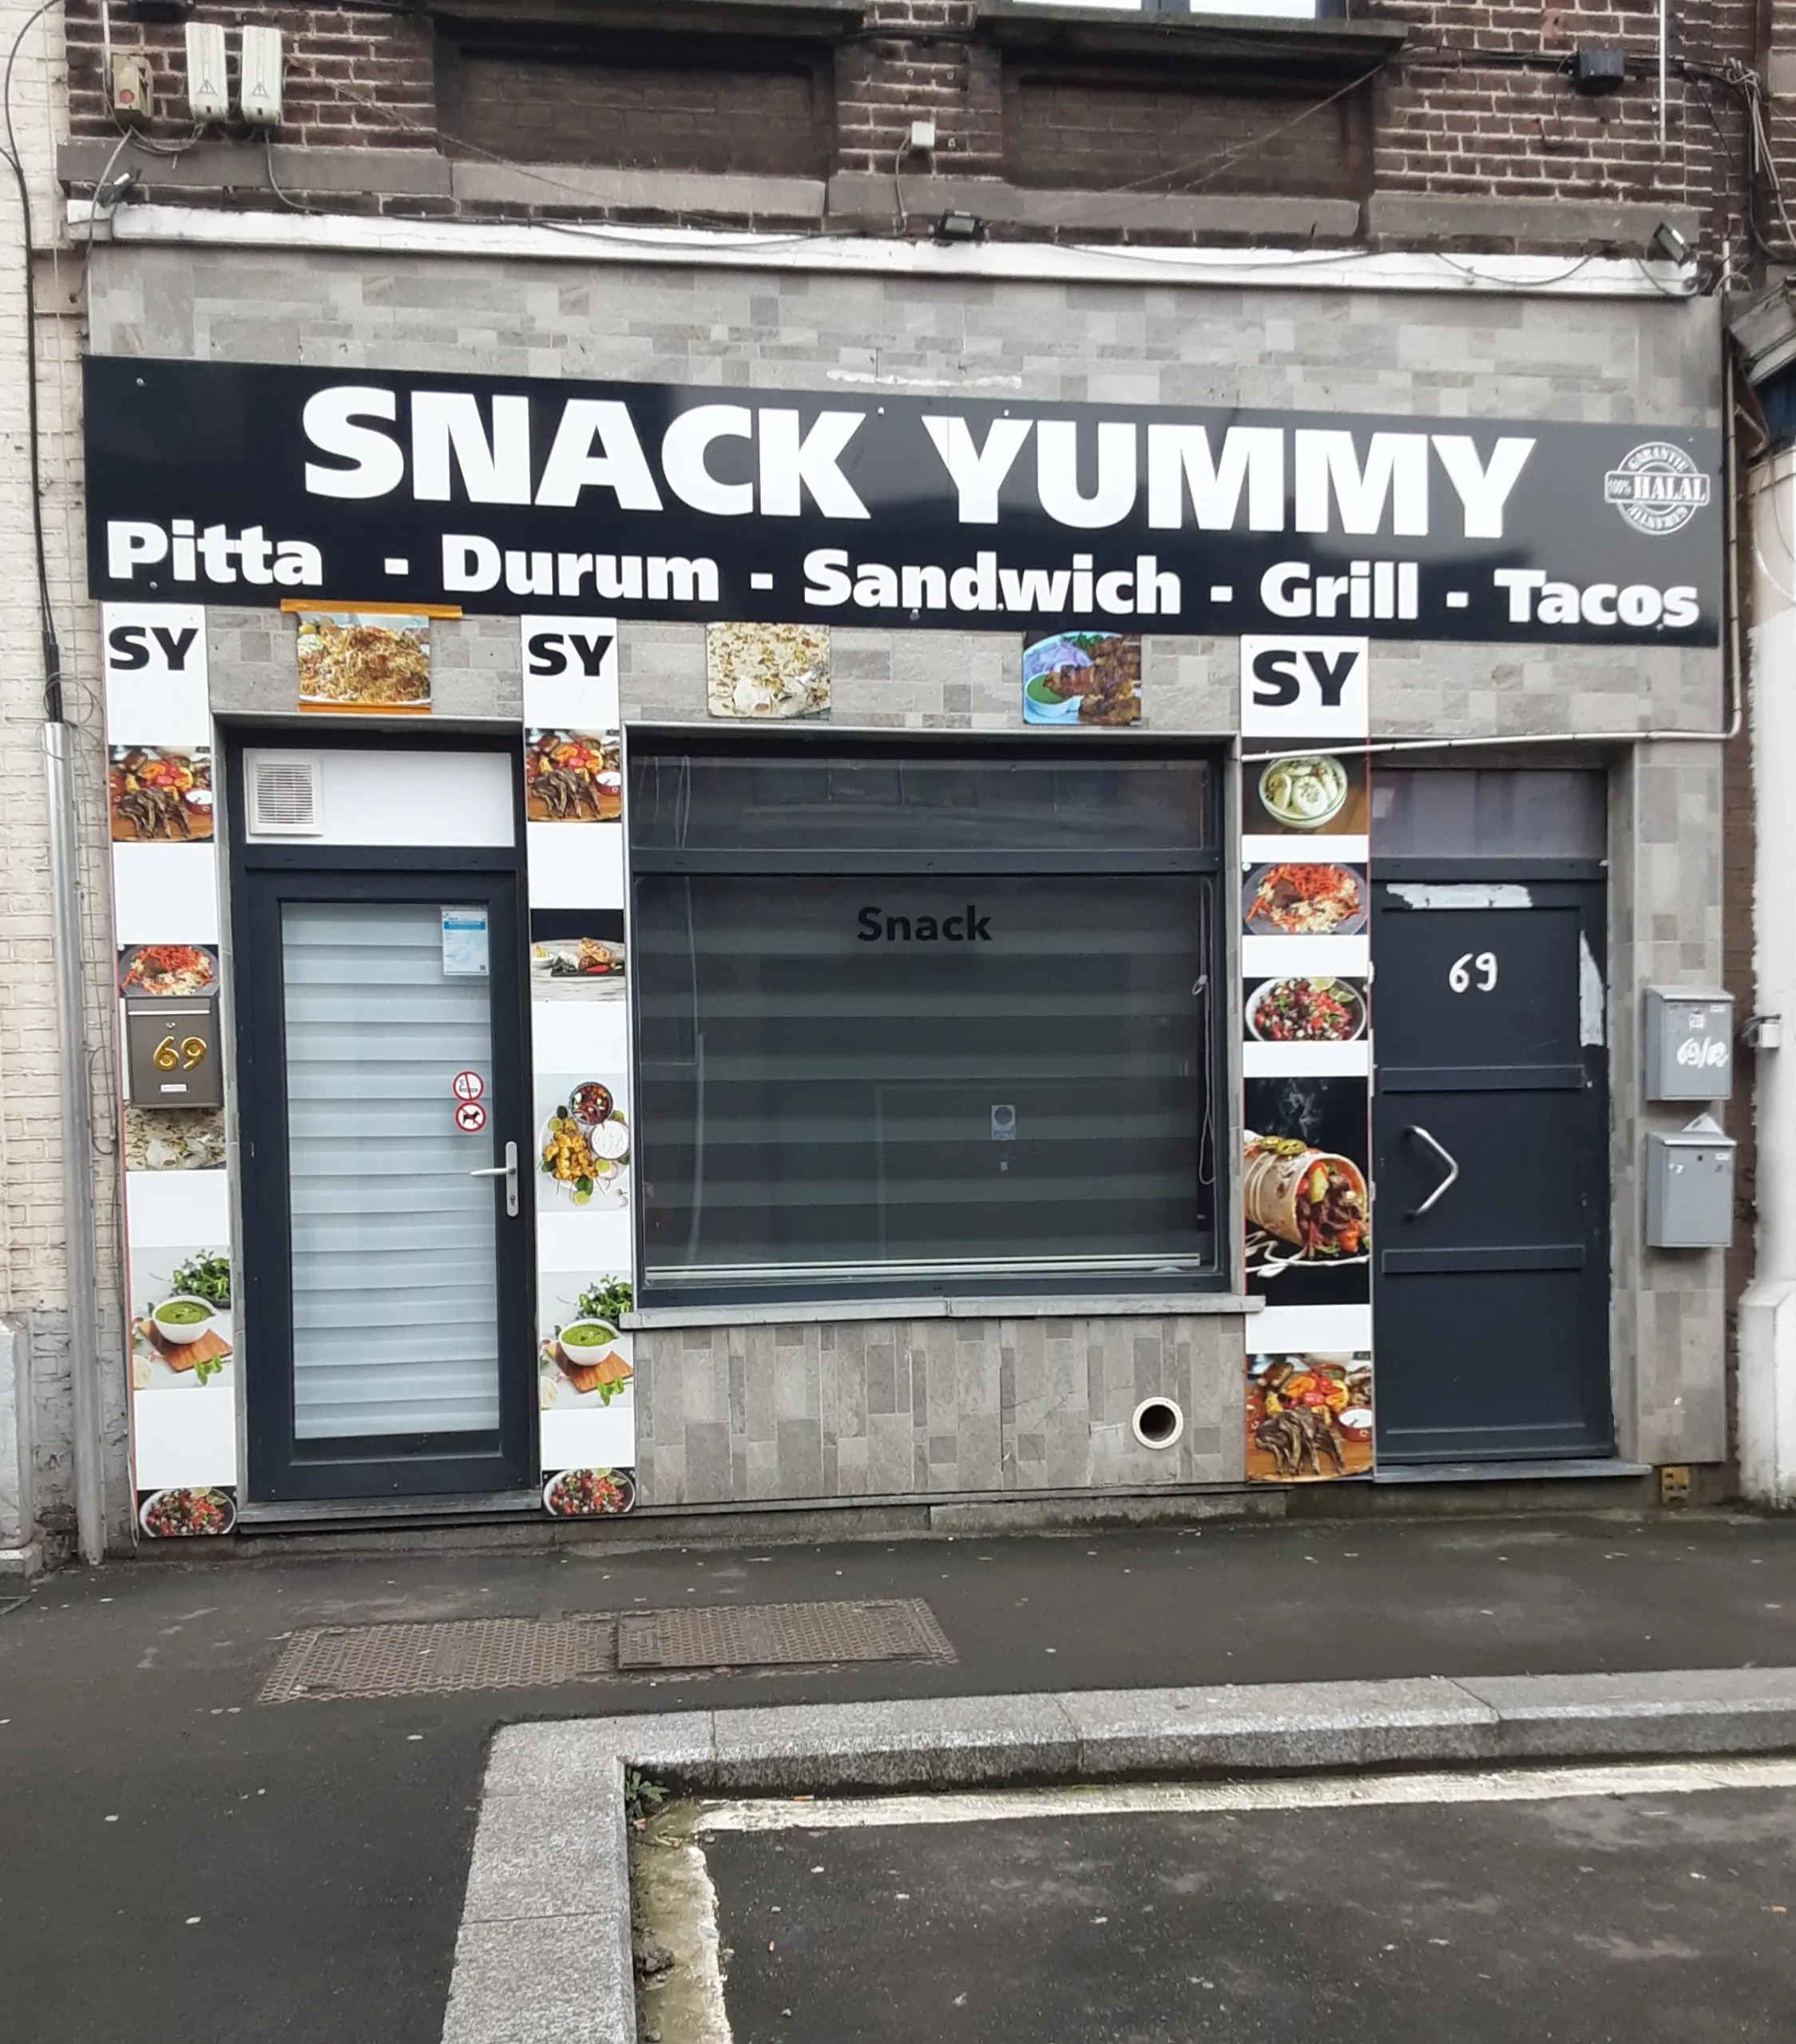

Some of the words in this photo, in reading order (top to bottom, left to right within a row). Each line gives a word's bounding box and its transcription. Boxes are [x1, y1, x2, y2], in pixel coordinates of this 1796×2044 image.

[303, 386, 871, 519] SNACK
[922, 415, 1536, 539] YUMMY
[1632, 475, 1707, 501] HALAL
[107, 519, 323, 585] Pitta
[385, 559, 408, 574] -
[442, 535, 718, 600] Durum
[751, 573, 772, 588] -
[804, 549, 1180, 613] Sandwich
[1211, 587, 1231, 601] -
[1261, 561, 1417, 619] Grill
[1447, 592, 1468, 607] -
[1494, 569, 1699, 628] Tacos
[109, 627, 197, 670] SY
[529, 634, 613, 675] SY
[1254, 651, 1358, 706] SY
[857, 905, 993, 942] Snack
[1449, 953, 1497, 992] 69
[153, 1036, 208, 1072] 69
